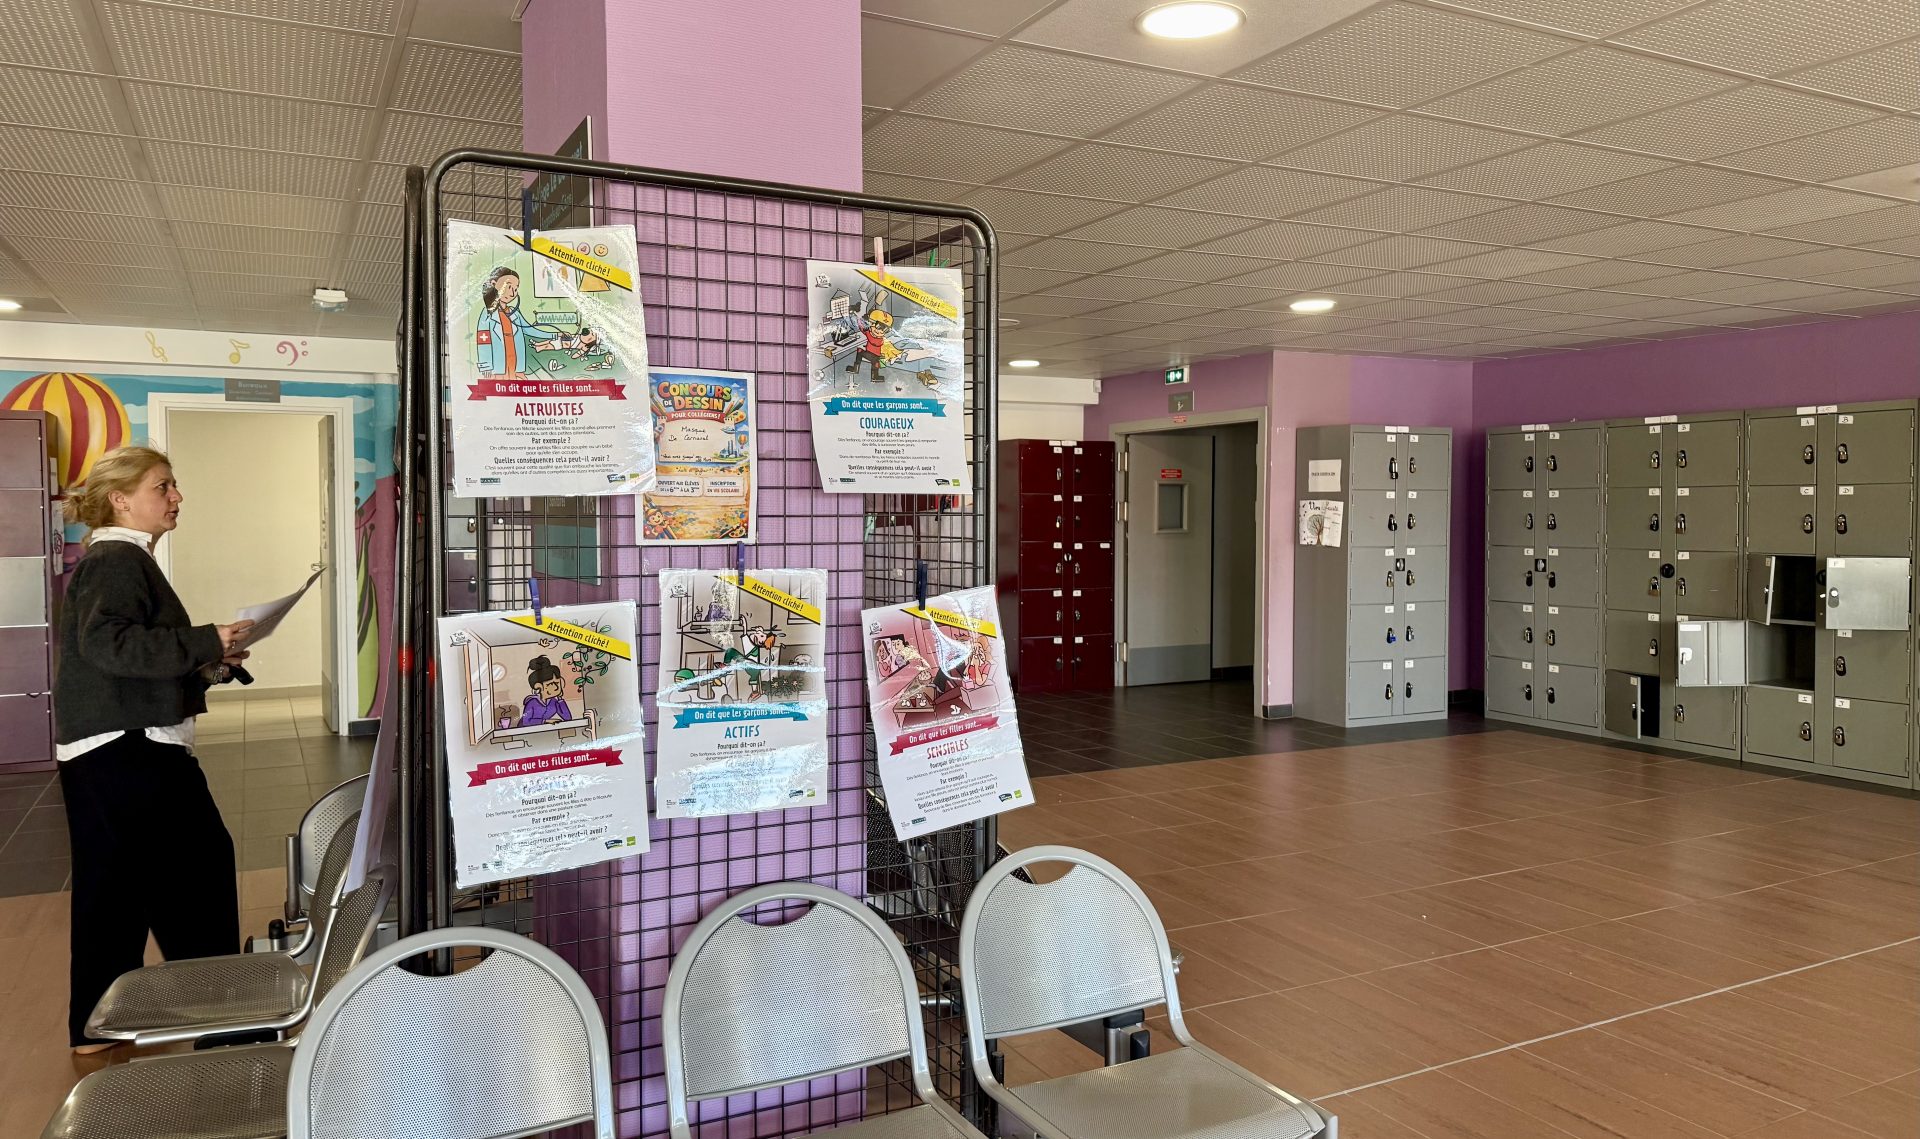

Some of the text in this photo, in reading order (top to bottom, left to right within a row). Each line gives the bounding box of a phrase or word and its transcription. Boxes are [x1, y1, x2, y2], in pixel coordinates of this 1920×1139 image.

[549, 246, 585, 266] Attention
[890, 280, 920, 299] Attention
[496, 384, 506, 392] On
[509, 383, 520, 392] dit
[522, 385, 537, 394] que
[539, 384, 550, 392] les
[553, 383, 573, 392] filles
[658, 381, 733, 402] CONCOURS
[515, 402, 584, 416] ALTRUISTES
[673, 396, 724, 411] DESSIN
[842, 400, 851, 408] On
[852, 400, 861, 408] dit
[863, 401, 874, 410] que
[886, 402, 908, 410] garçons
[522, 418, 547, 426] Pourquoi
[860, 418, 914, 430] COURAGEUX
[494, 456, 516, 465] Quelles
[517, 456, 554, 464] conséquences
[569, 456, 590, 464] peut-il
[752, 583, 782, 602] Attention
[930, 610, 959, 624] Attention
[547, 622, 584, 640] Attention
[695, 712, 704, 720] On
[706, 711, 716, 719] dit
[718, 711, 730, 720] que
[732, 709, 742, 718] les
[743, 709, 768, 719] garçons
[725, 725, 760, 739] ACTIFS
[909, 735, 918, 744] On
[919, 733, 927, 741] dit
[928, 731, 938, 740] que
[949, 724, 964, 734] filles
[927, 738, 969, 760] SENSIBLES
[495, 765, 506, 774] On
[508, 764, 520, 773] dit
[522, 762, 536, 772] que
[538, 760, 549, 768] les
[551, 757, 571, 767] filles
[522, 796, 546, 806] Pourquoi
[548, 793, 566, 802] dit-on
